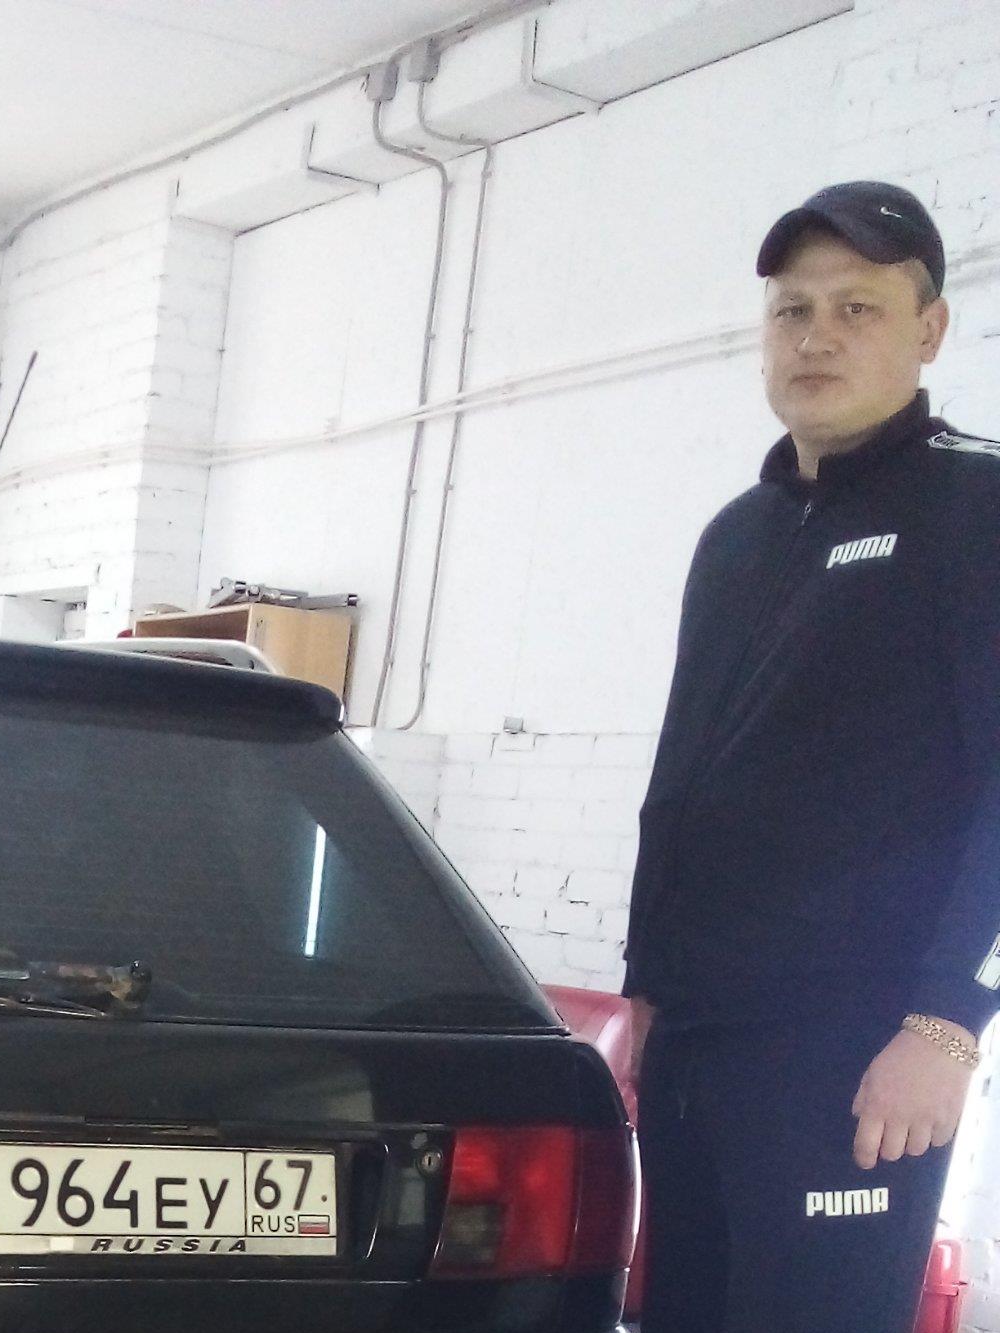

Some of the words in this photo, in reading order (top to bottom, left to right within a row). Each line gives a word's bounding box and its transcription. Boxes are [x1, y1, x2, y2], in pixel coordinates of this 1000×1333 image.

[826, 533, 898, 569] PUMA
[253, 1159, 313, 1211] 67
[805, 1187, 889, 1217] PUMA
[251, 1215, 296, 1233] RUS
[90, 1237, 248, 1253] RUSSIA
